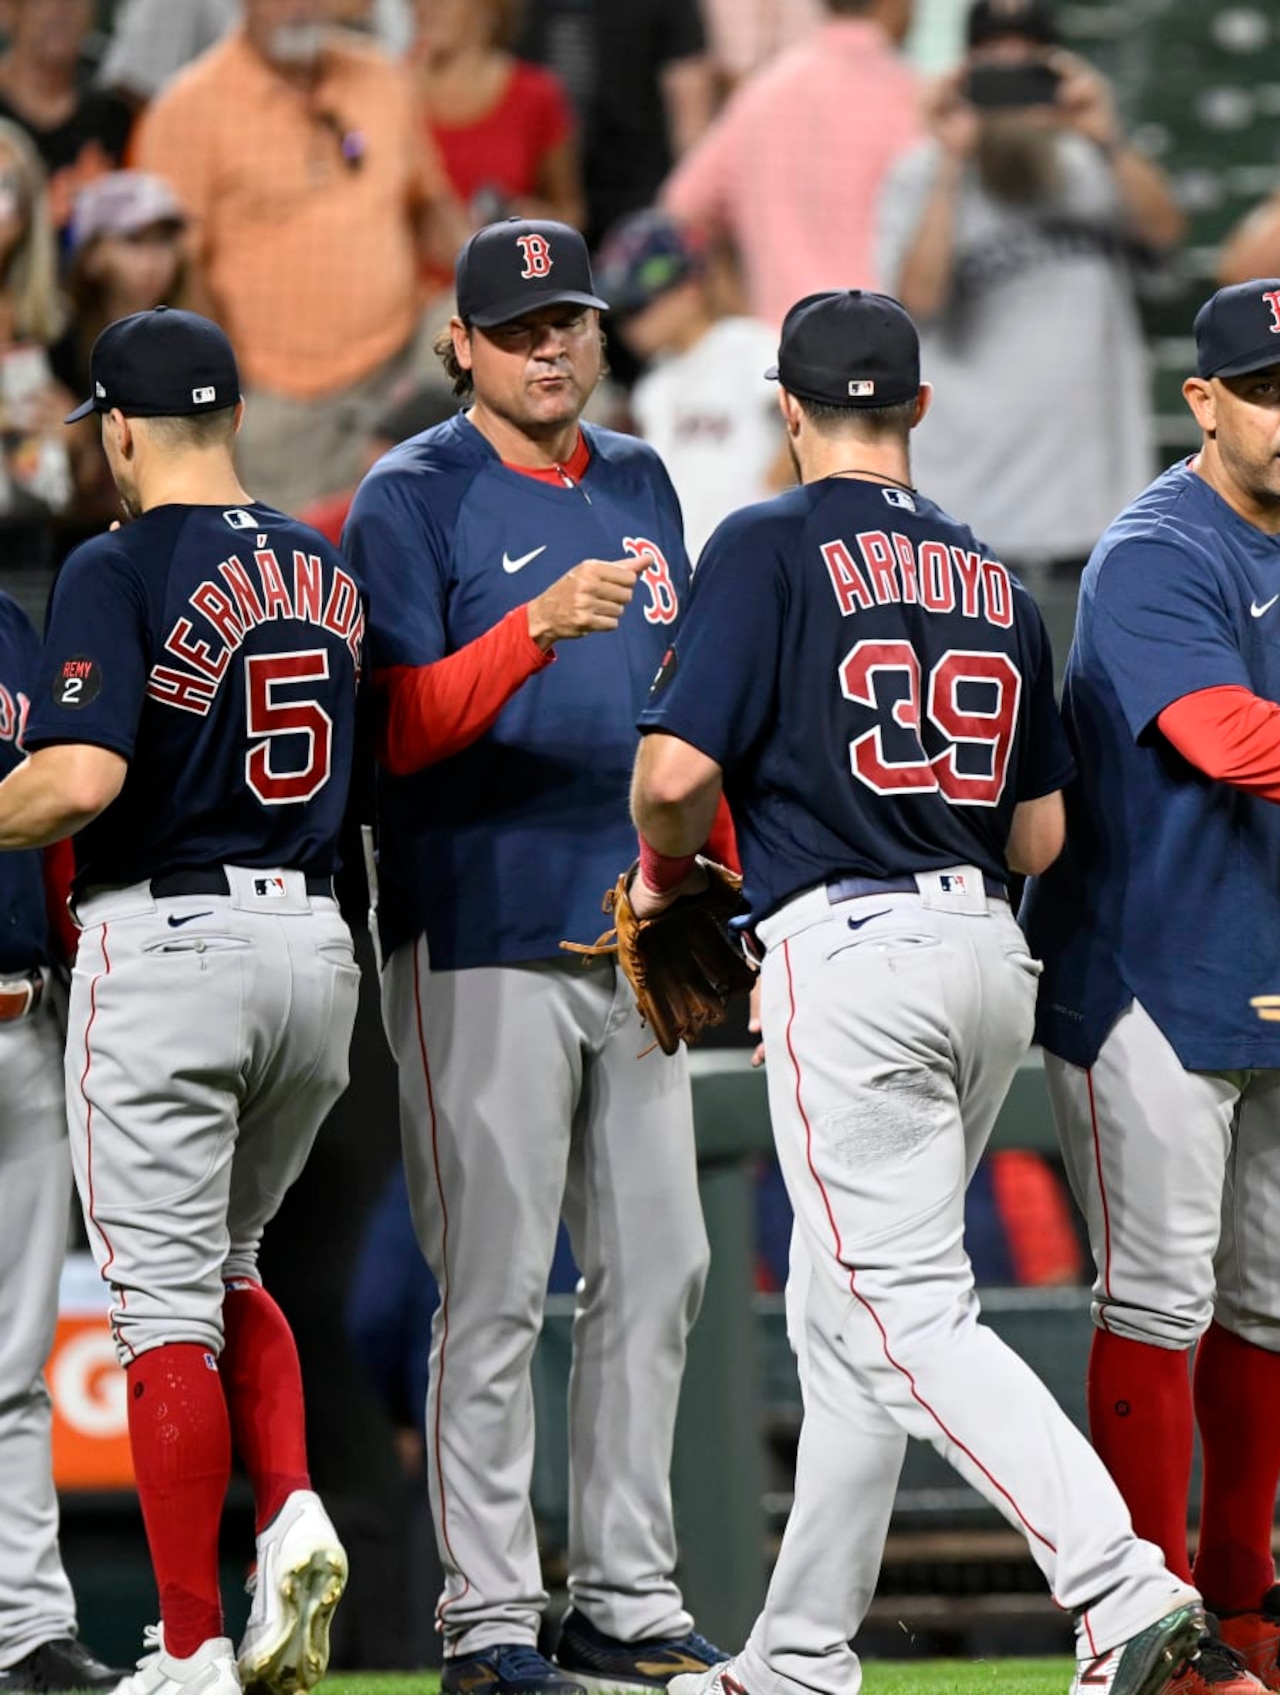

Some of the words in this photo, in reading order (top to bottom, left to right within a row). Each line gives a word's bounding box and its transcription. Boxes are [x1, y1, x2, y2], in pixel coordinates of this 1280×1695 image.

[516, 234, 553, 279] B
[147, 533, 365, 717] HERNÁND
[820, 530, 1013, 629] ARROYO
[61, 677, 83, 703] 2
[62, 661, 92, 679] REMY
[244, 648, 333, 806] 5
[838, 639, 1022, 808] 39
